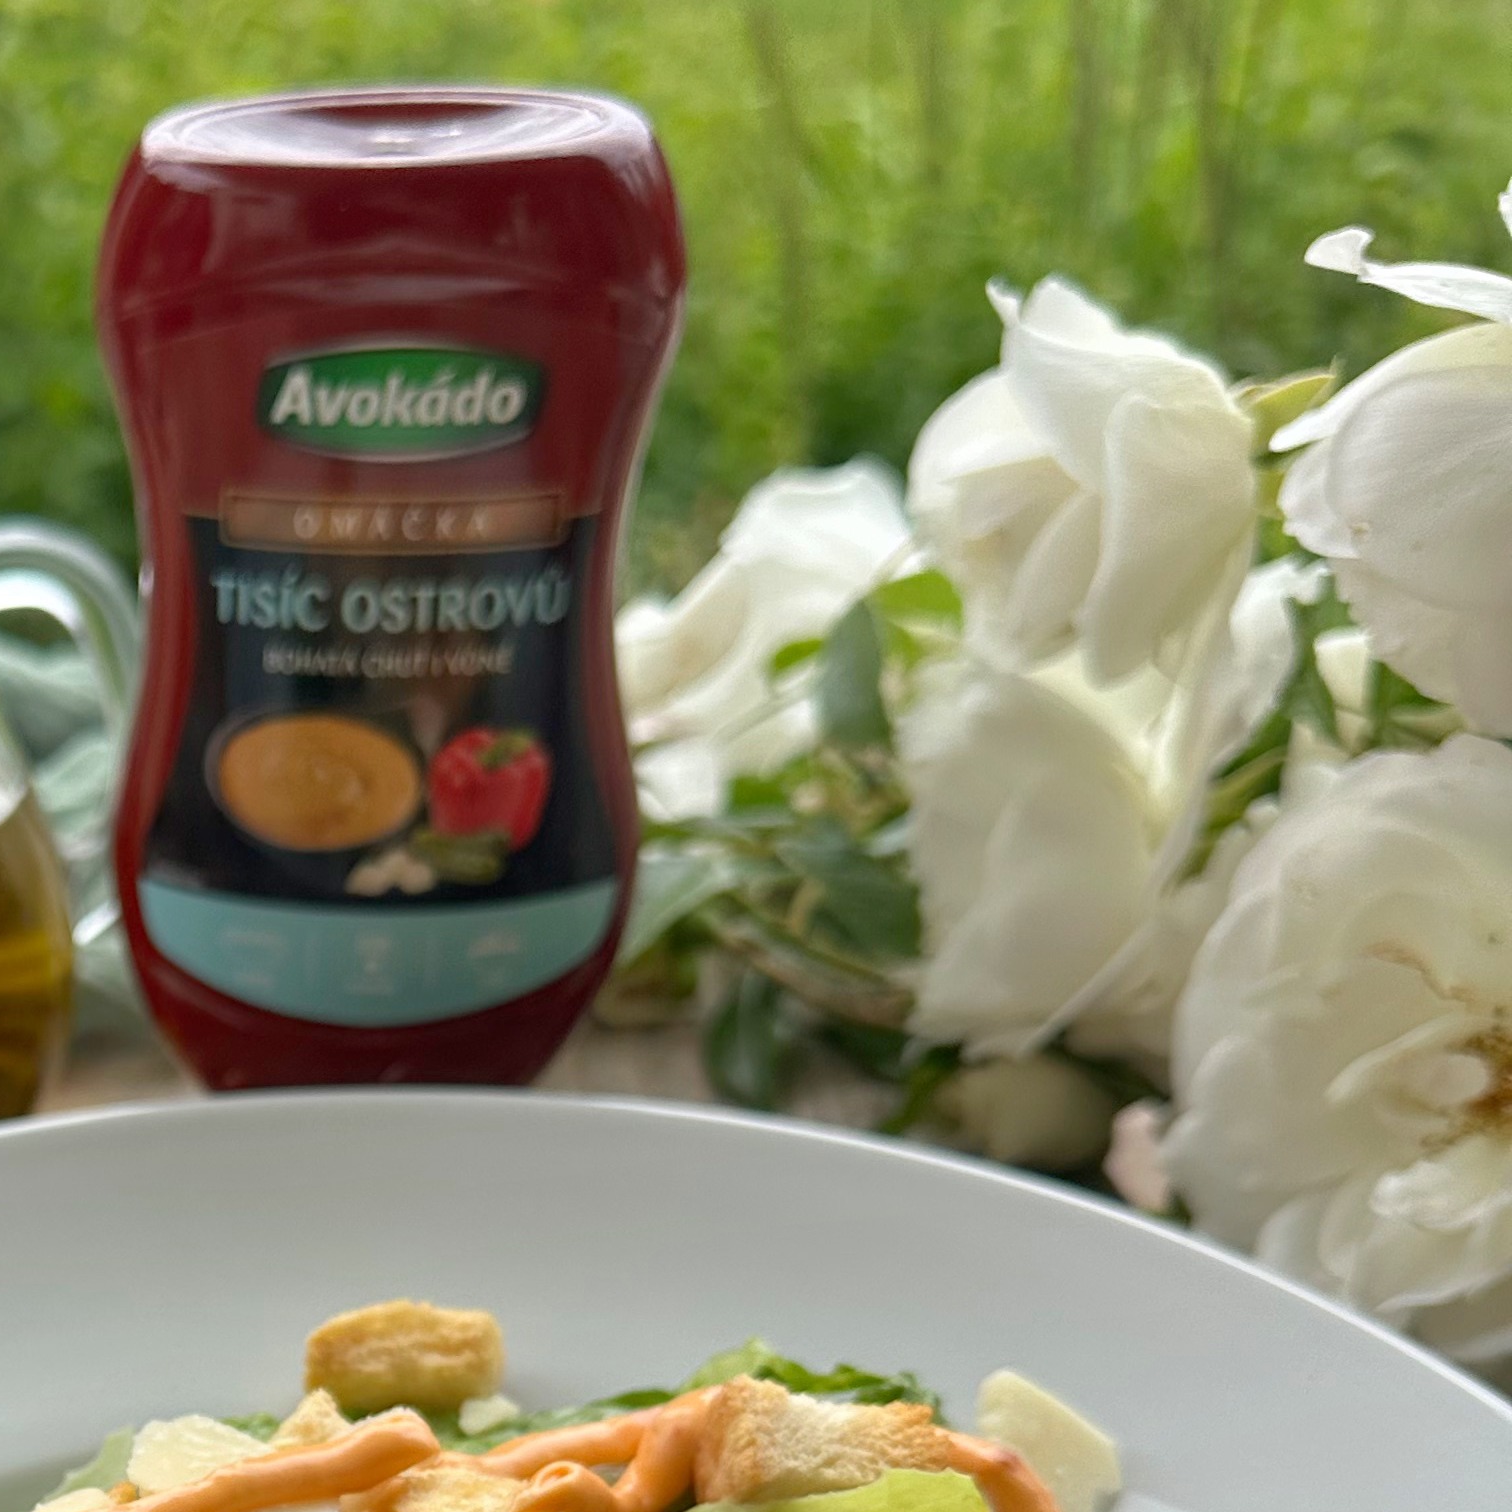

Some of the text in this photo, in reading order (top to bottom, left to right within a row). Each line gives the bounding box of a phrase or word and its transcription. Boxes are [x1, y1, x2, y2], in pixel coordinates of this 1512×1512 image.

[270, 366, 527, 426] Avokádo
[212, 562, 571, 634] TISÍC OSTROVŮ
